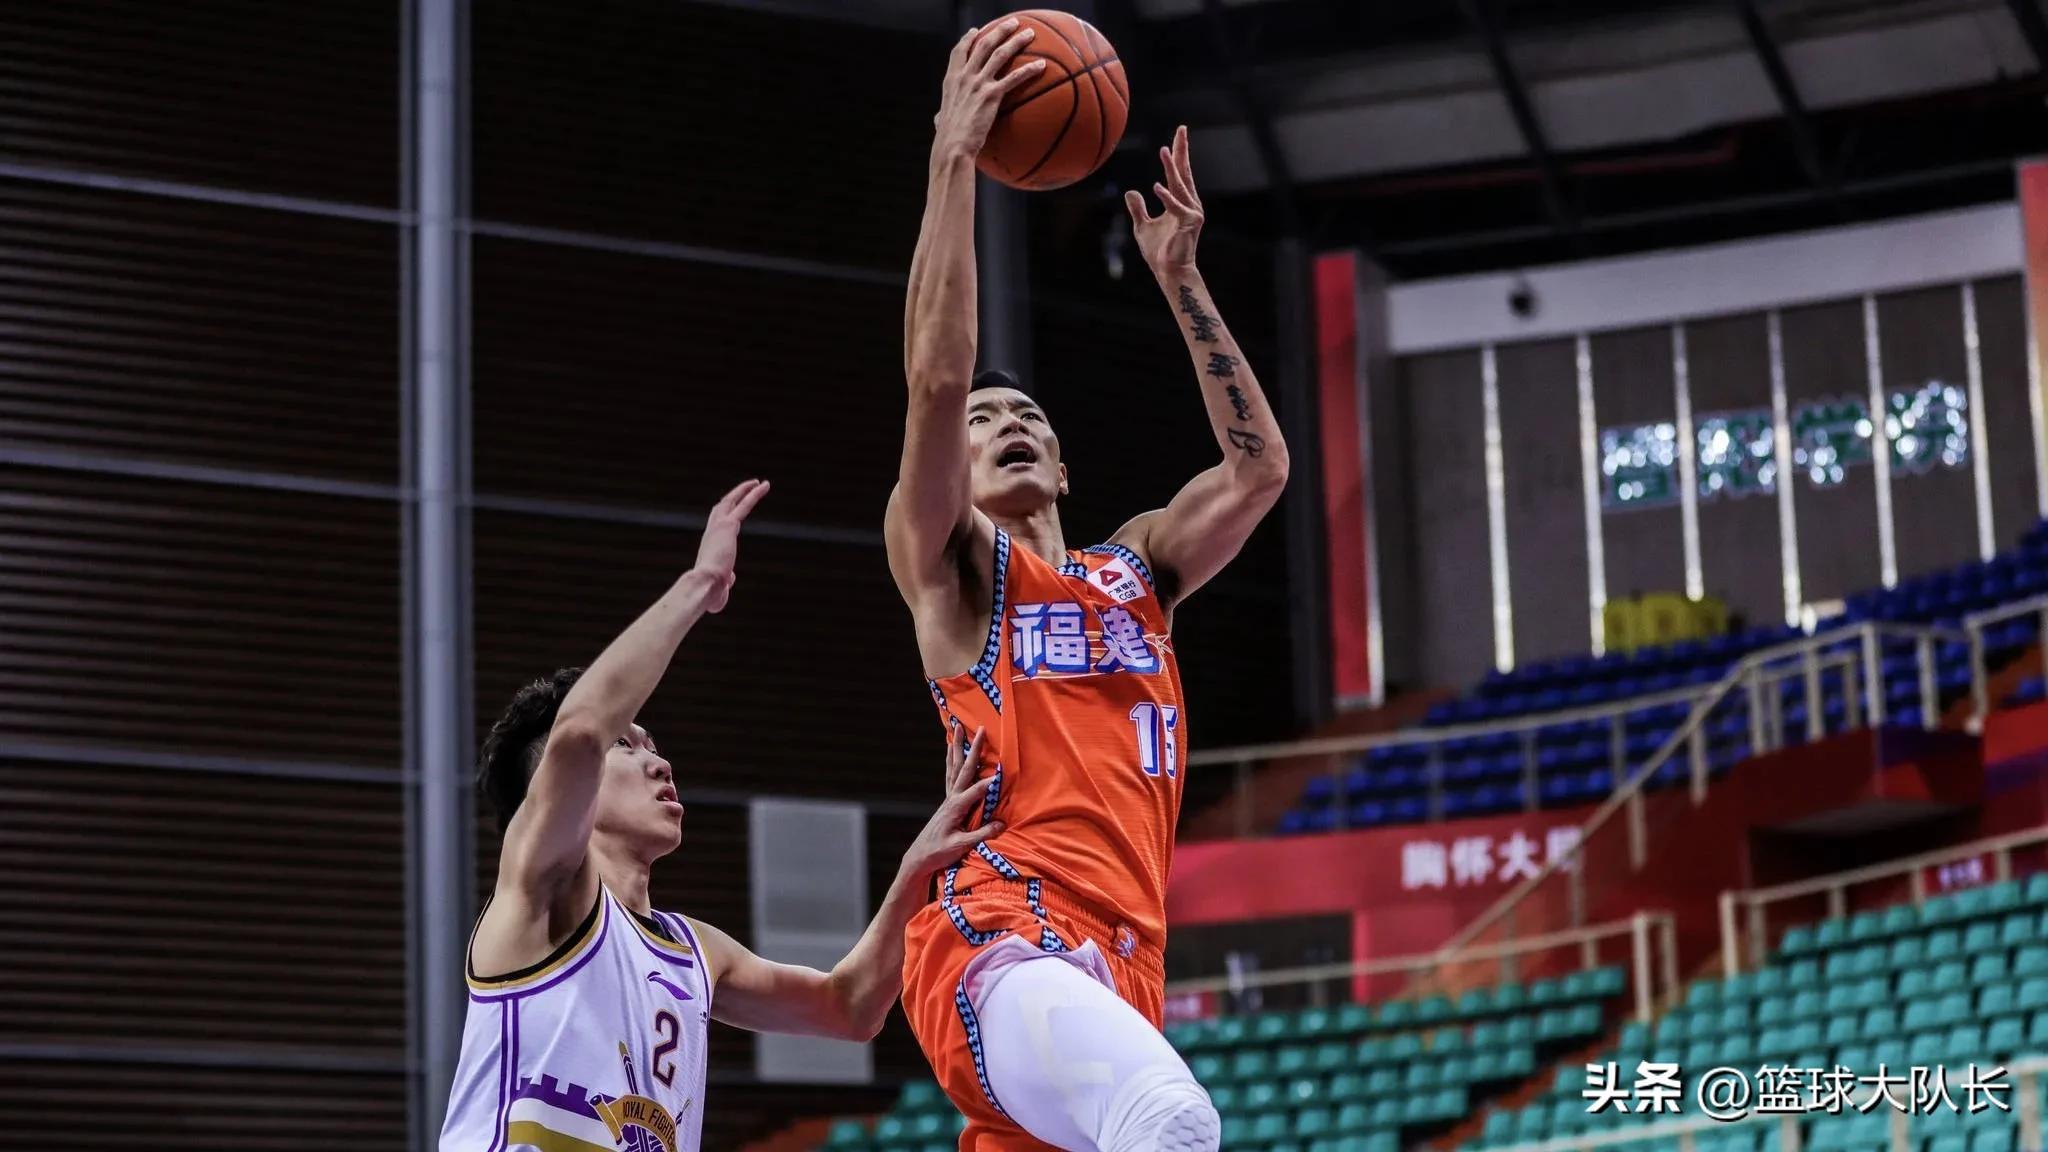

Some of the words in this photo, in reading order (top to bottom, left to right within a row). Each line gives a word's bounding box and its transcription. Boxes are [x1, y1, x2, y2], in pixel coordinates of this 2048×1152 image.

[1118, 589, 1137, 601] CGB
[1009, 602, 1160, 678] 福建
[1129, 702, 1178, 778] 15
[652, 1007, 681, 1089] 2
